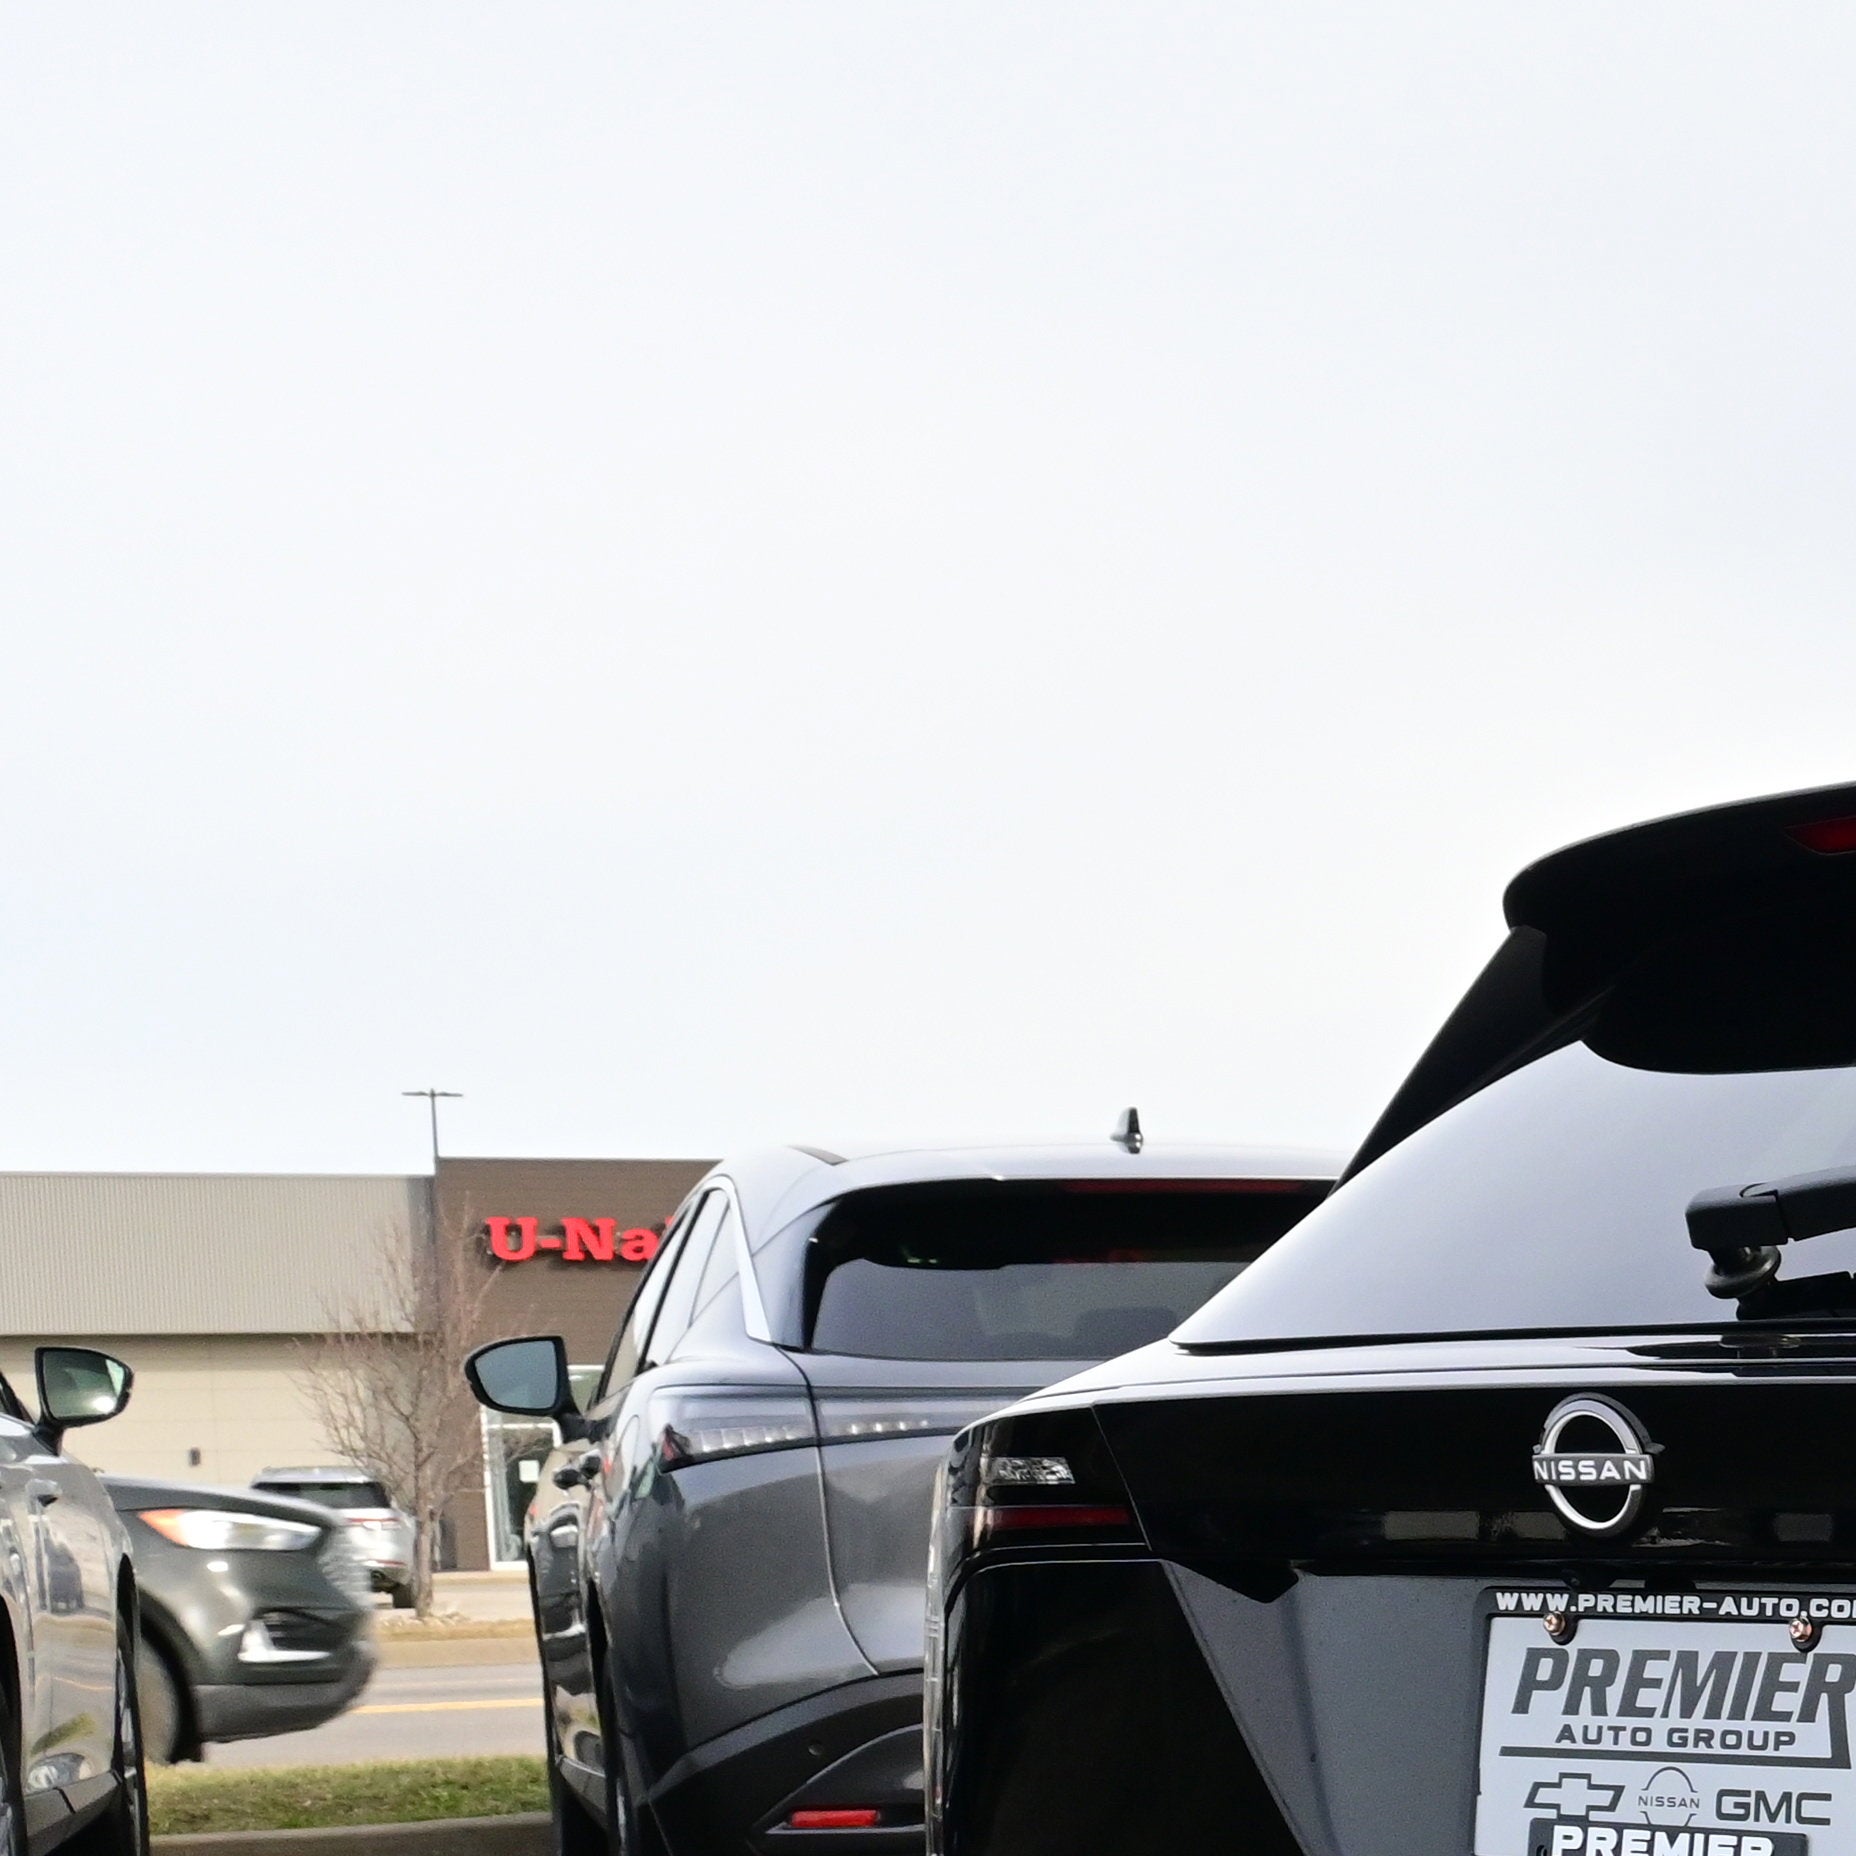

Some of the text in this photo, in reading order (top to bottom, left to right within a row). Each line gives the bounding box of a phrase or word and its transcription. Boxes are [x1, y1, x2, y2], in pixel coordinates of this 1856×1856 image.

[486, 1216, 674, 1262] U-Na
[1533, 1459, 1648, 1481] NISSAN
[1555, 1723, 1797, 1752] AUTO GROUP
[1637, 1794, 1701, 1810] NISSAN
[1715, 1788, 1833, 1826] GMC
